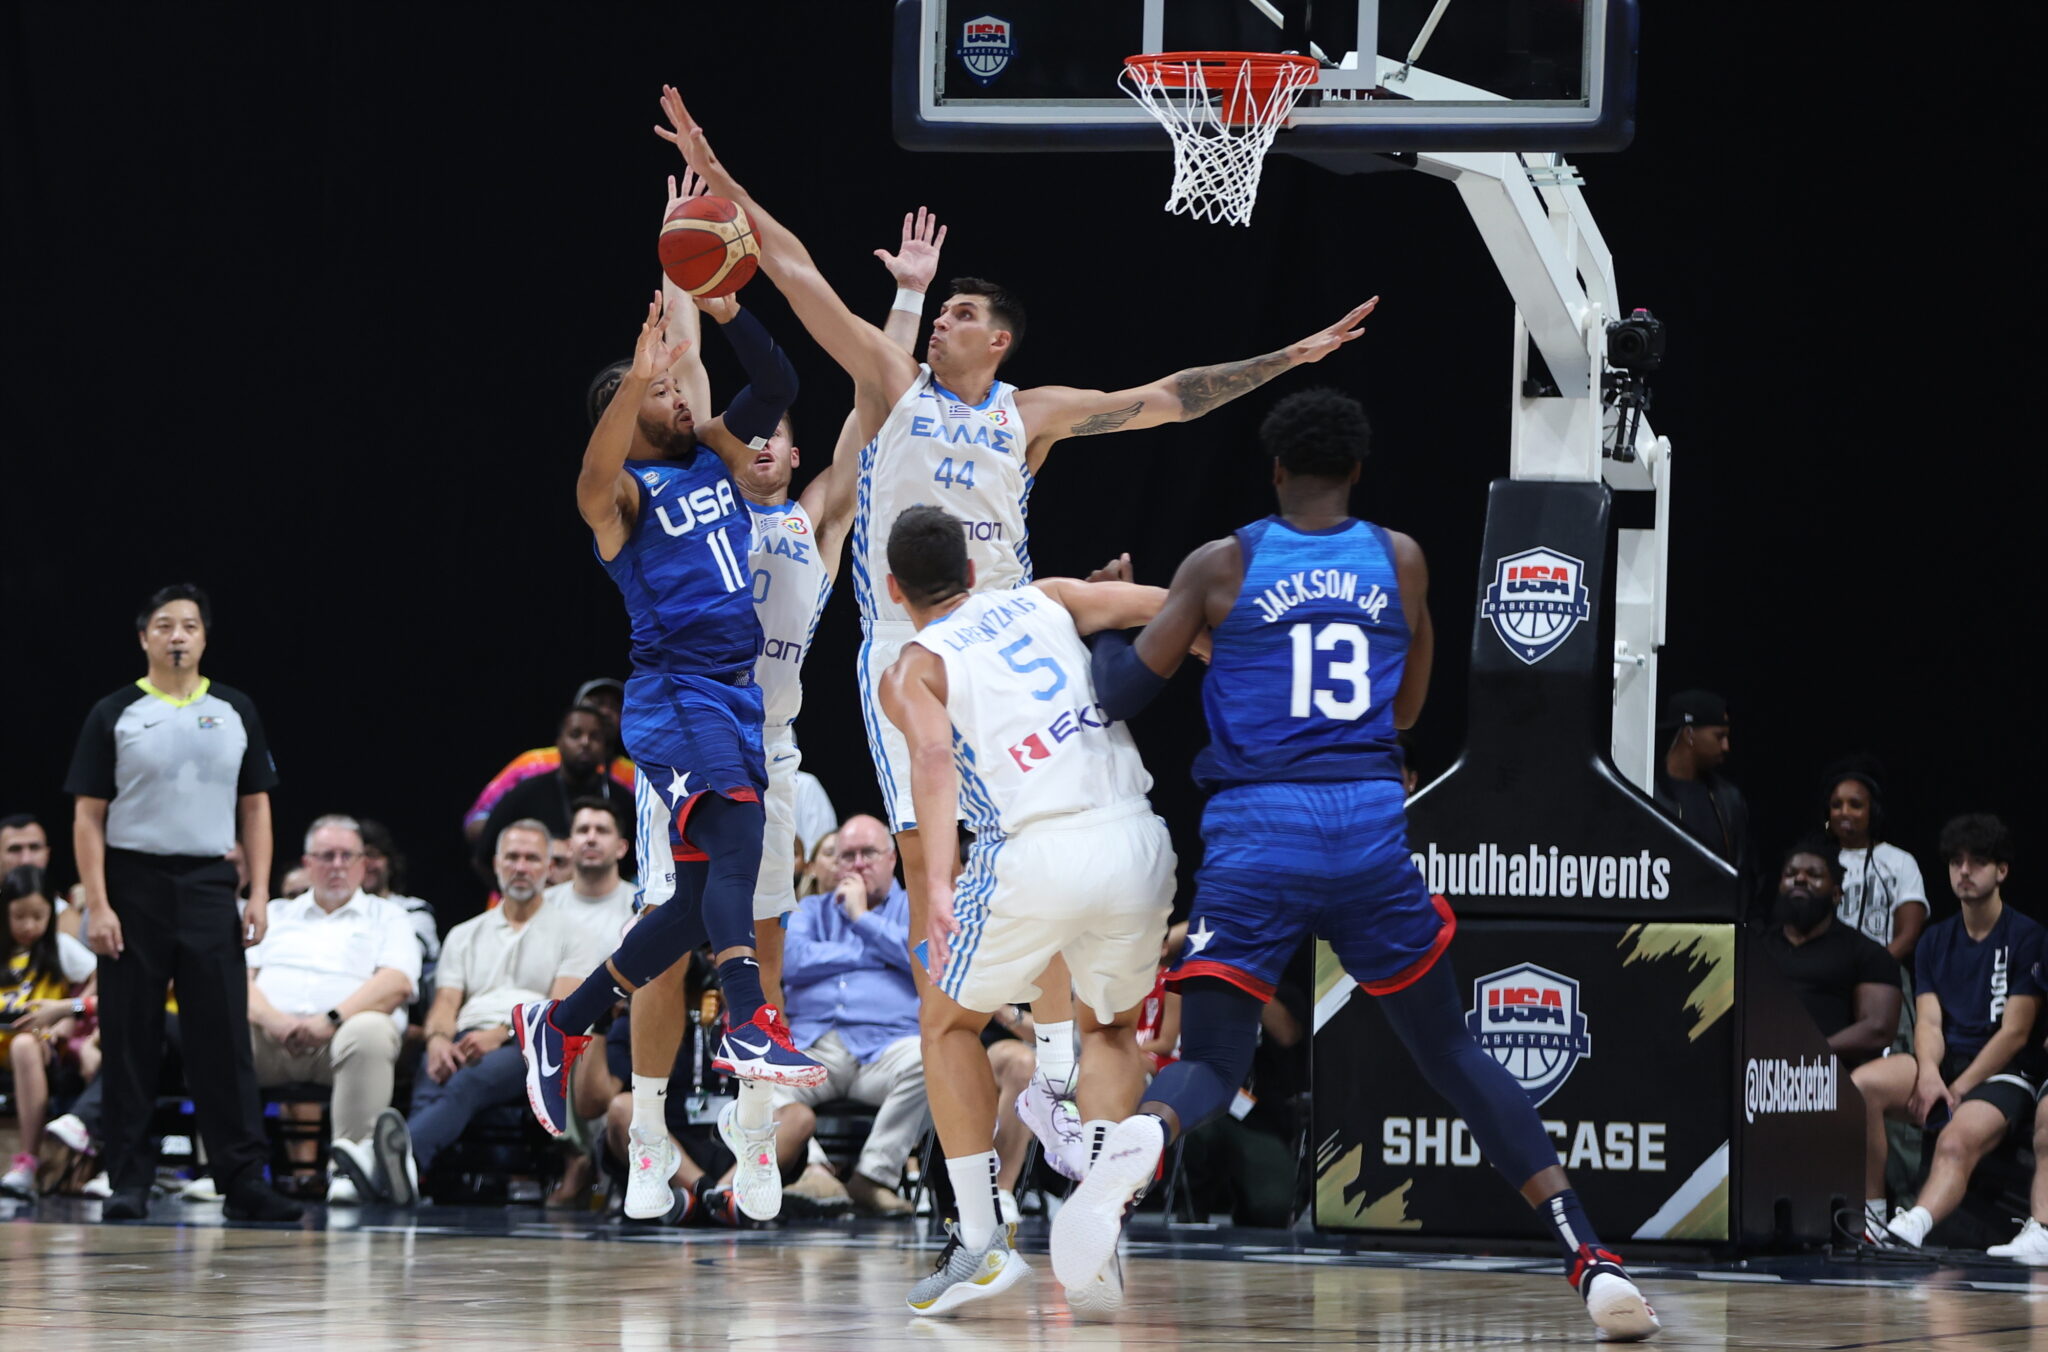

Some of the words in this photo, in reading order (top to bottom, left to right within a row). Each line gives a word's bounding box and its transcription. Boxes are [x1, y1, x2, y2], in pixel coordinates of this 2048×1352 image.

[957, 48, 1014, 56] BASKETBALL
[967, 24, 1006, 44] USA
[910, 416, 1013, 454] ΕΛΛΑΣ
[934, 457, 975, 490] 44
[655, 478, 737, 537] USA
[706, 526, 746, 593] 11
[747, 533, 810, 565] ΛΑΣ
[1253, 569, 1358, 623] JACKSON
[1357, 584, 1389, 624] JR.
[1507, 566, 1570, 595] USA
[1489, 602, 1581, 614] BASKETBALL
[998, 633, 1068, 701] 5
[1288, 622, 1372, 721] 13
[1488, 986, 1566, 1026] USA
[1745, 1053, 1838, 1124] @USABasketball
[1383, 1116, 1667, 1171] SHOCASE
